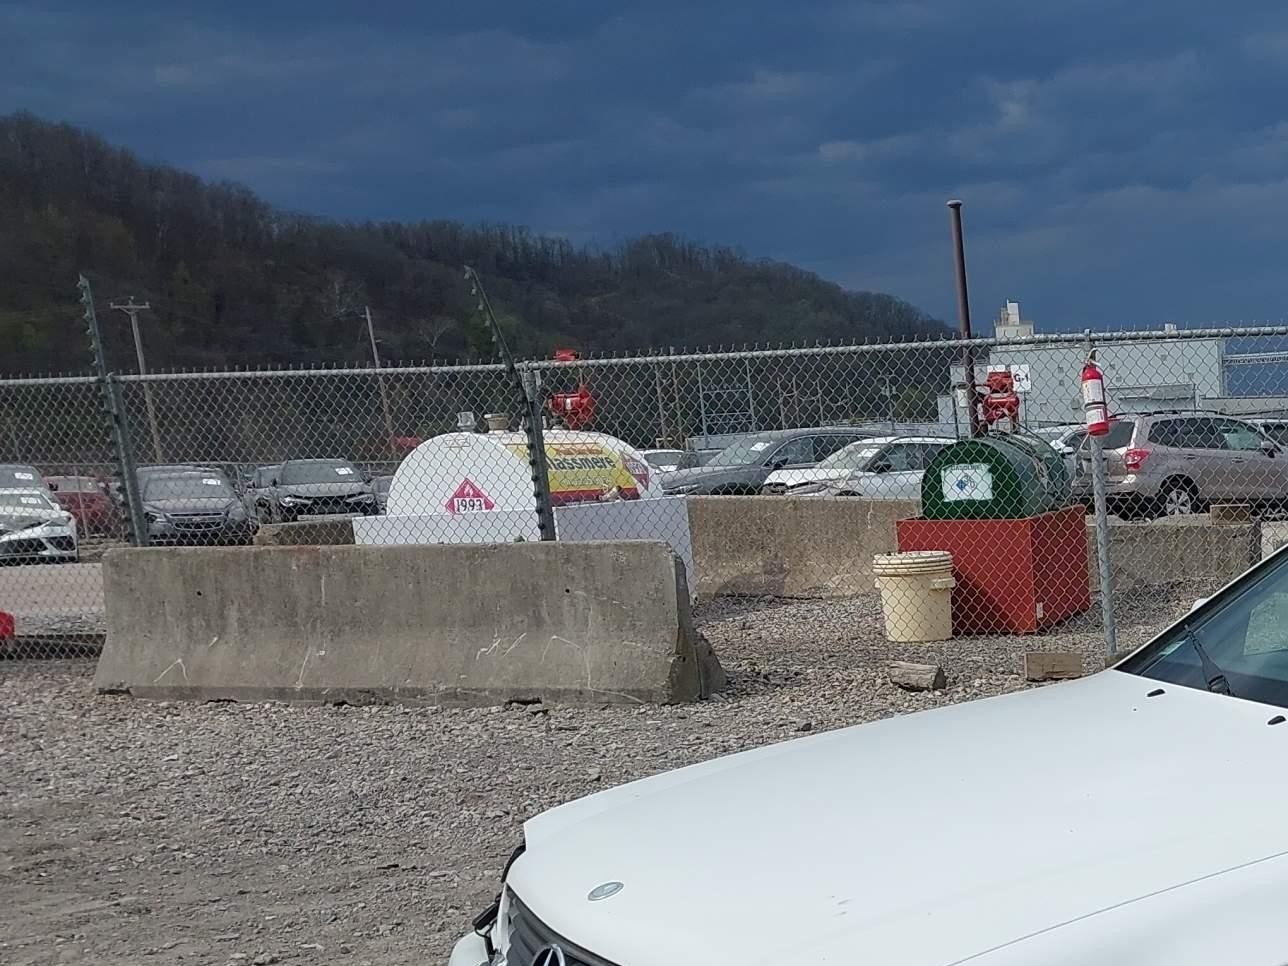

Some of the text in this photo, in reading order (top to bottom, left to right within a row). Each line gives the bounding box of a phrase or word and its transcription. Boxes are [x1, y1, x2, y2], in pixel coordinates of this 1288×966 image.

[1013, 373, 1029, 382] G-1
[546, 456, 616, 470] lassmere
[456, 498, 483, 511] 1993
